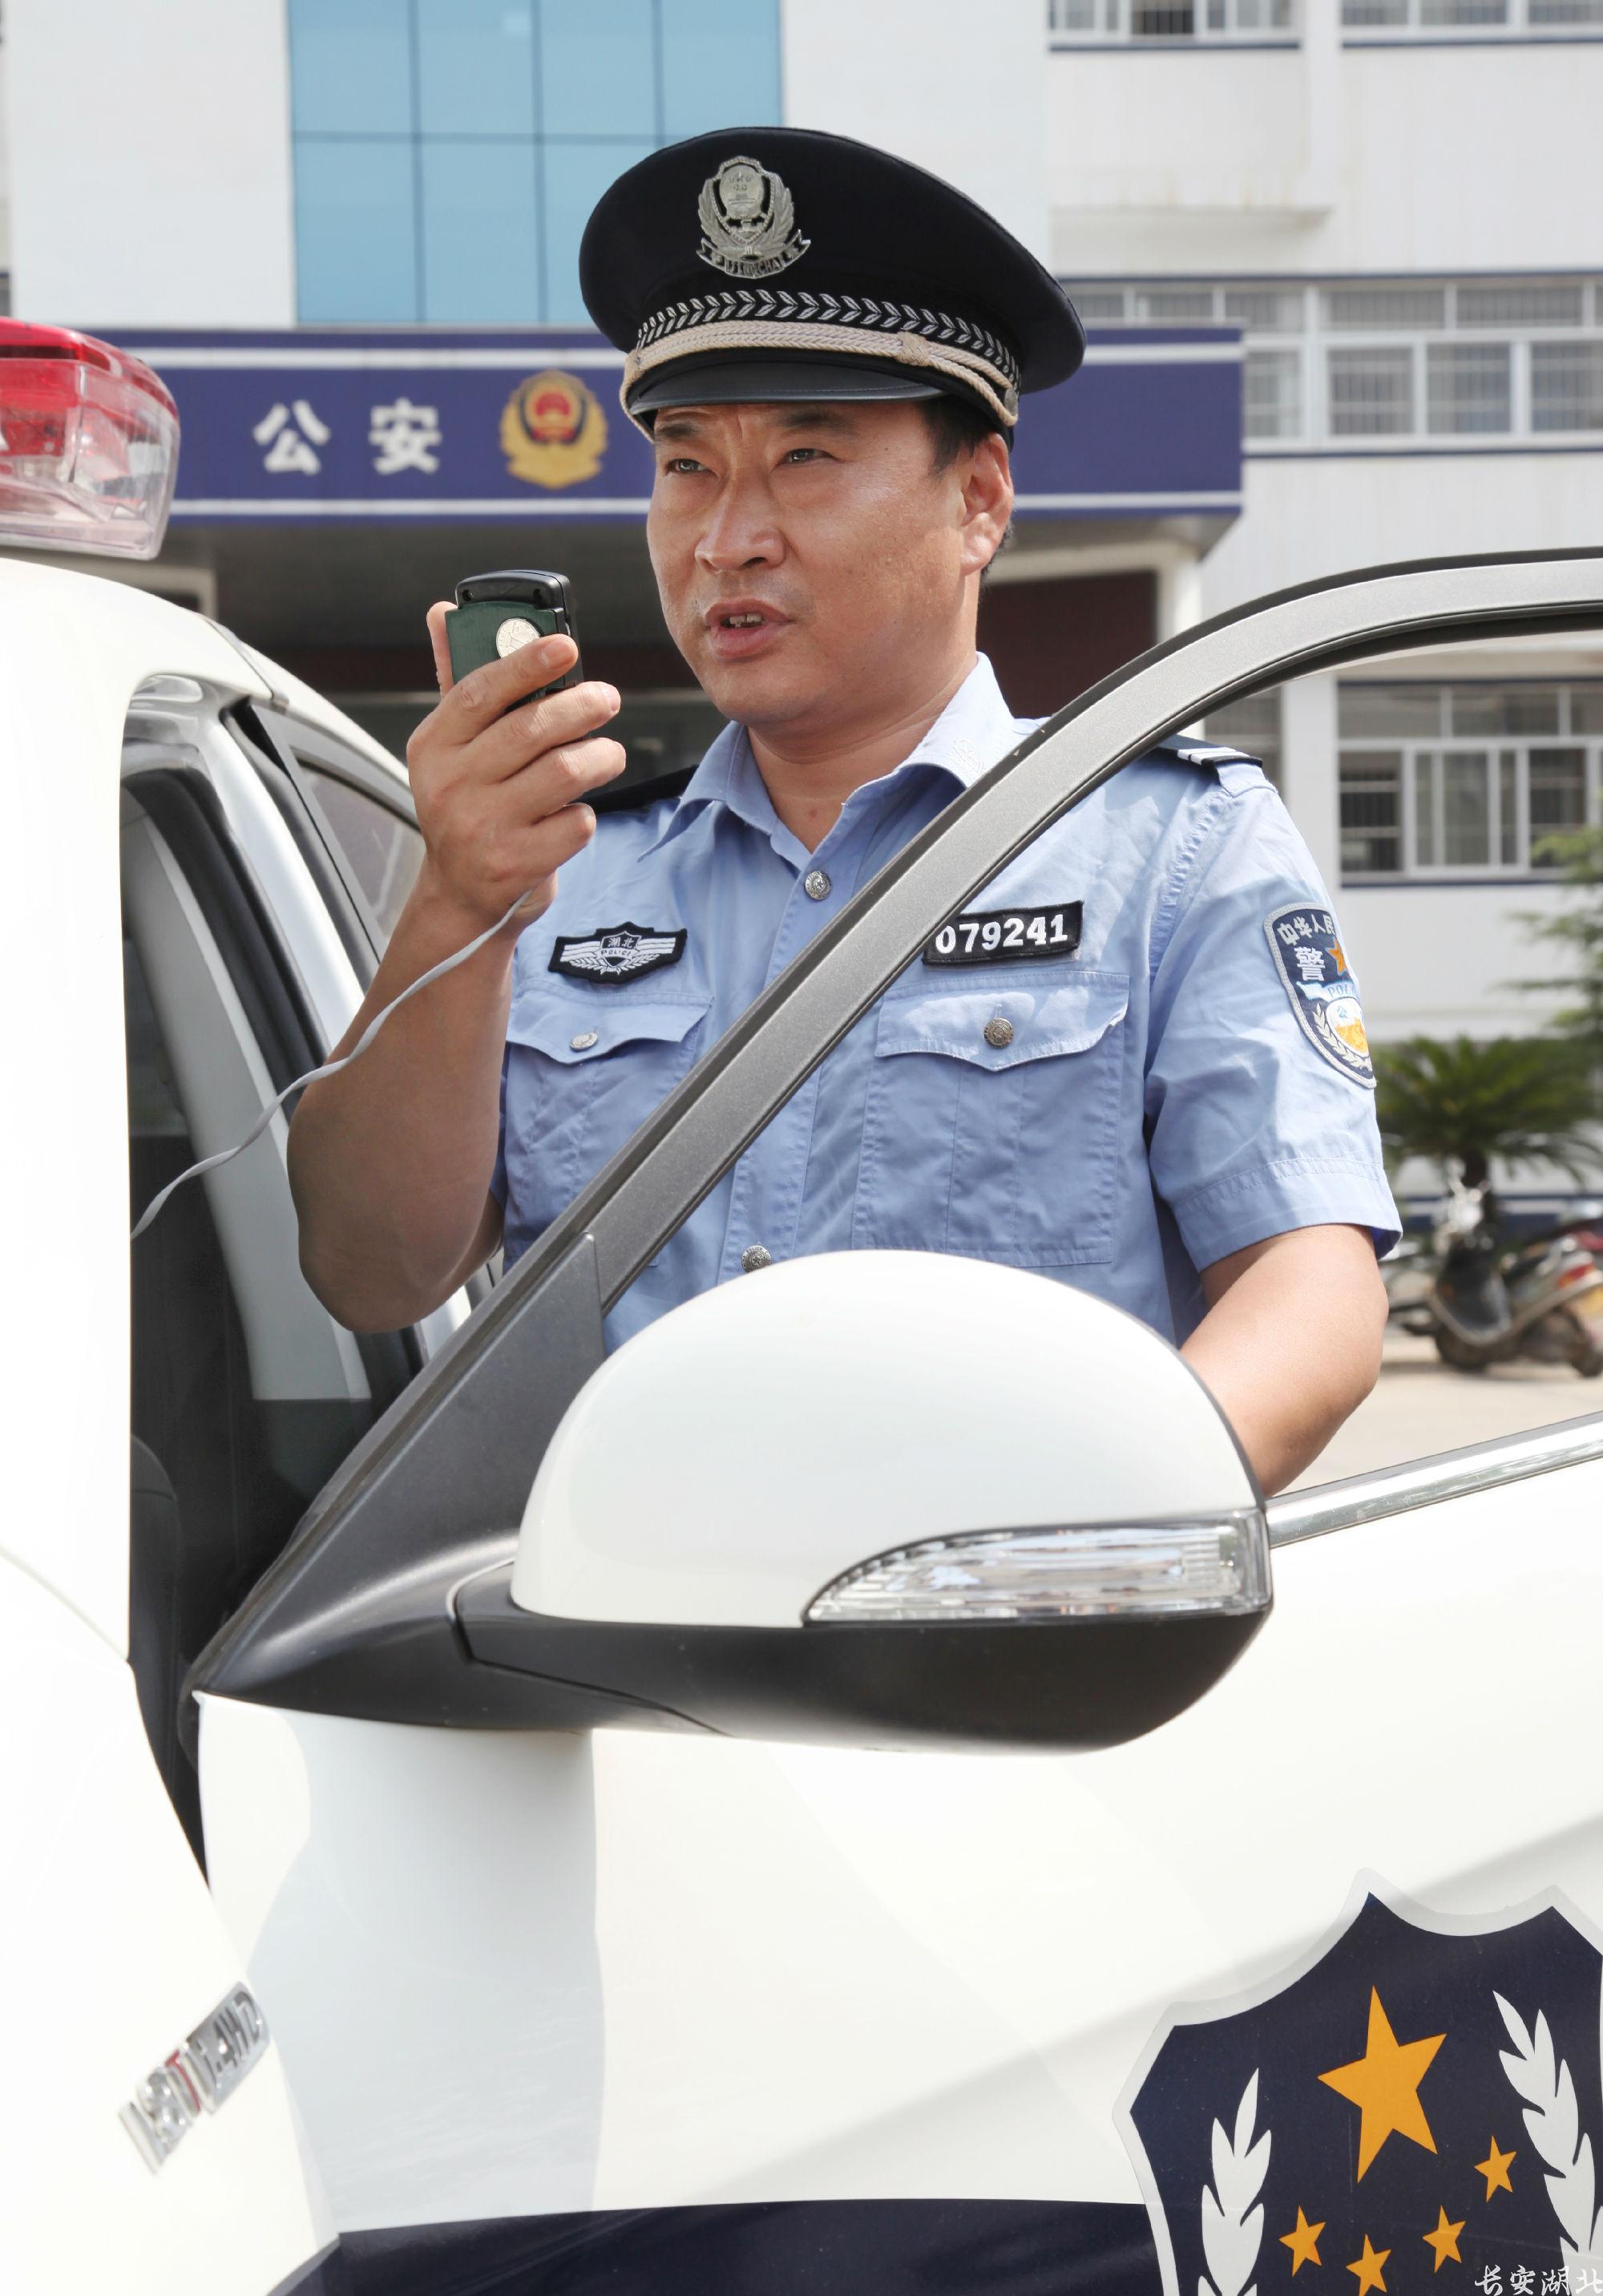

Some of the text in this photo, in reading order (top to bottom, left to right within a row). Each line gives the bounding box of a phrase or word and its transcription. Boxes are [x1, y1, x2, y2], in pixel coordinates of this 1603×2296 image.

[253, 398, 442, 475] 公安
[608, 937, 634, 948] 湖北
[935, 914, 1068, 954] 079241
